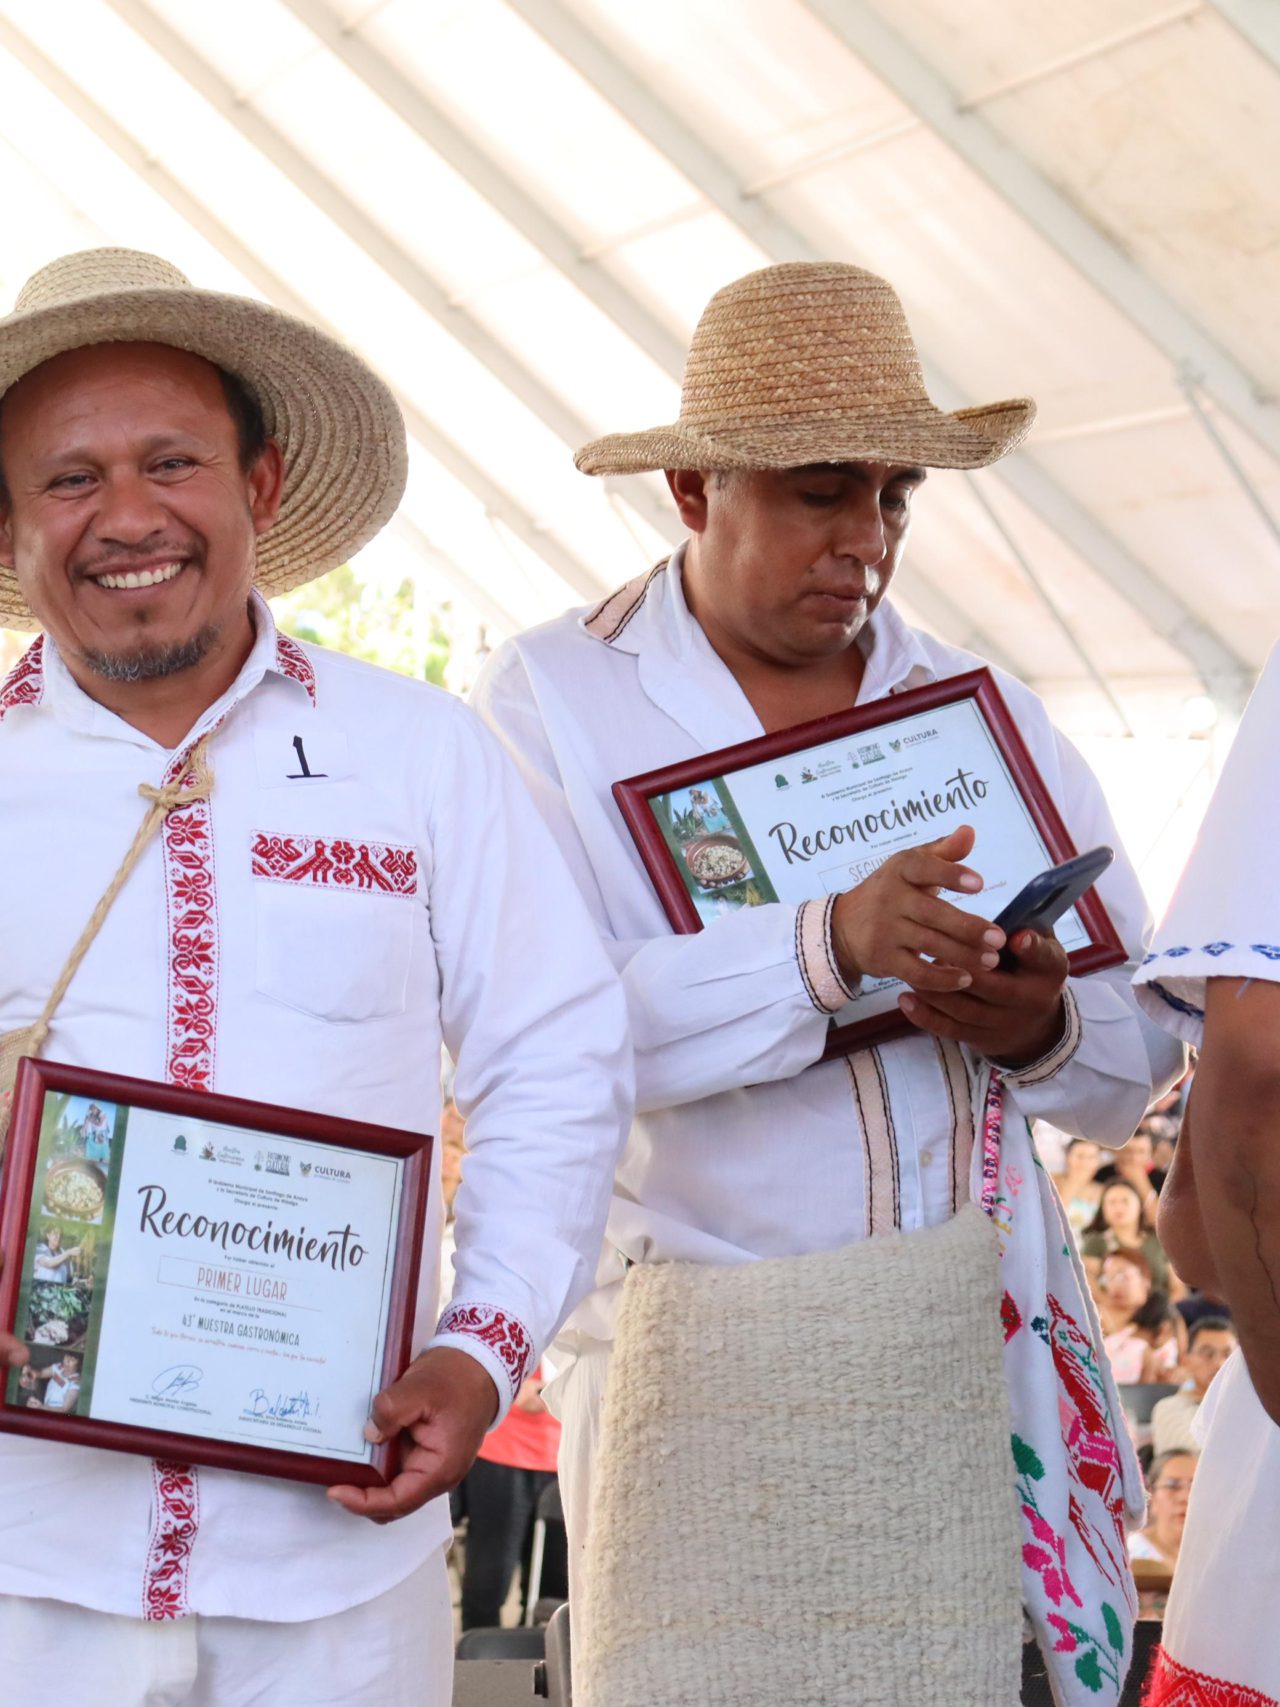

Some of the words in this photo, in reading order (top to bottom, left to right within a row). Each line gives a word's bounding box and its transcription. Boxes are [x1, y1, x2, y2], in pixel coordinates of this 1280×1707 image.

[903, 729, 938, 744] CULTURA
[286, 735, 328, 779] 1
[768, 768, 990, 865] Reconocimiento
[313, 1165, 352, 1179] CULTURA
[137, 1184, 369, 1271] Reconocimiento
[197, 1267, 243, 1292] PRIMER
[246, 1276, 287, 1301] LUGAR
[197, 1316, 234, 1335] MUESTRA
[237, 1322, 300, 1347] GASTRONÓMICA
